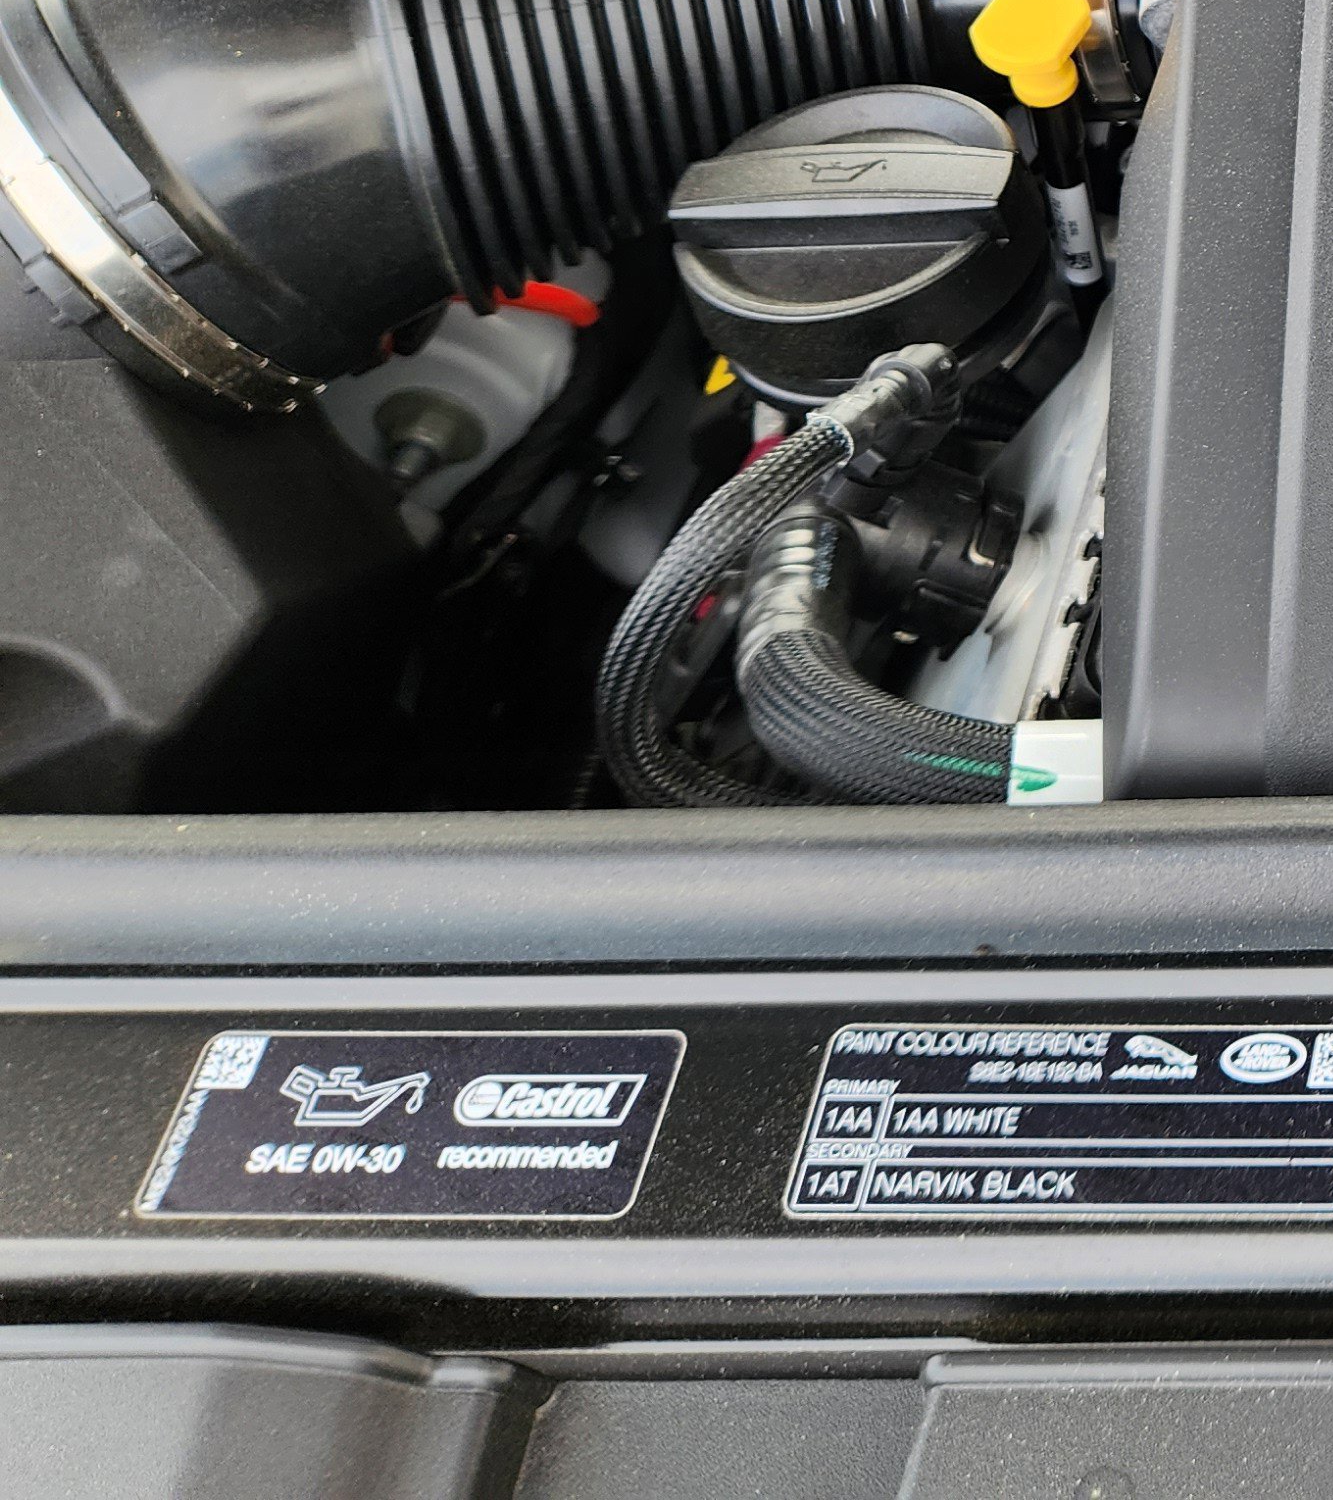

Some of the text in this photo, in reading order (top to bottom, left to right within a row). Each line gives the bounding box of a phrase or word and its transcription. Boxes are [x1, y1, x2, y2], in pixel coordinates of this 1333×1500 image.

[834, 1030, 1112, 1057] PAINT COLOUR REFERENCE
[1109, 1064, 1198, 1080] JAGUAR
[496, 1080, 615, 1119] Castrol
[822, 1079, 901, 1094] PRIMARY
[824, 1106, 1022, 1133] 1AA 1AA WHITE
[245, 1143, 406, 1173] SAE 0W-30
[436, 1140, 619, 1170] recommended
[805, 1143, 913, 1159] SECONDARY
[806, 1169, 1077, 1199] 1AT NARVIK BLACK
